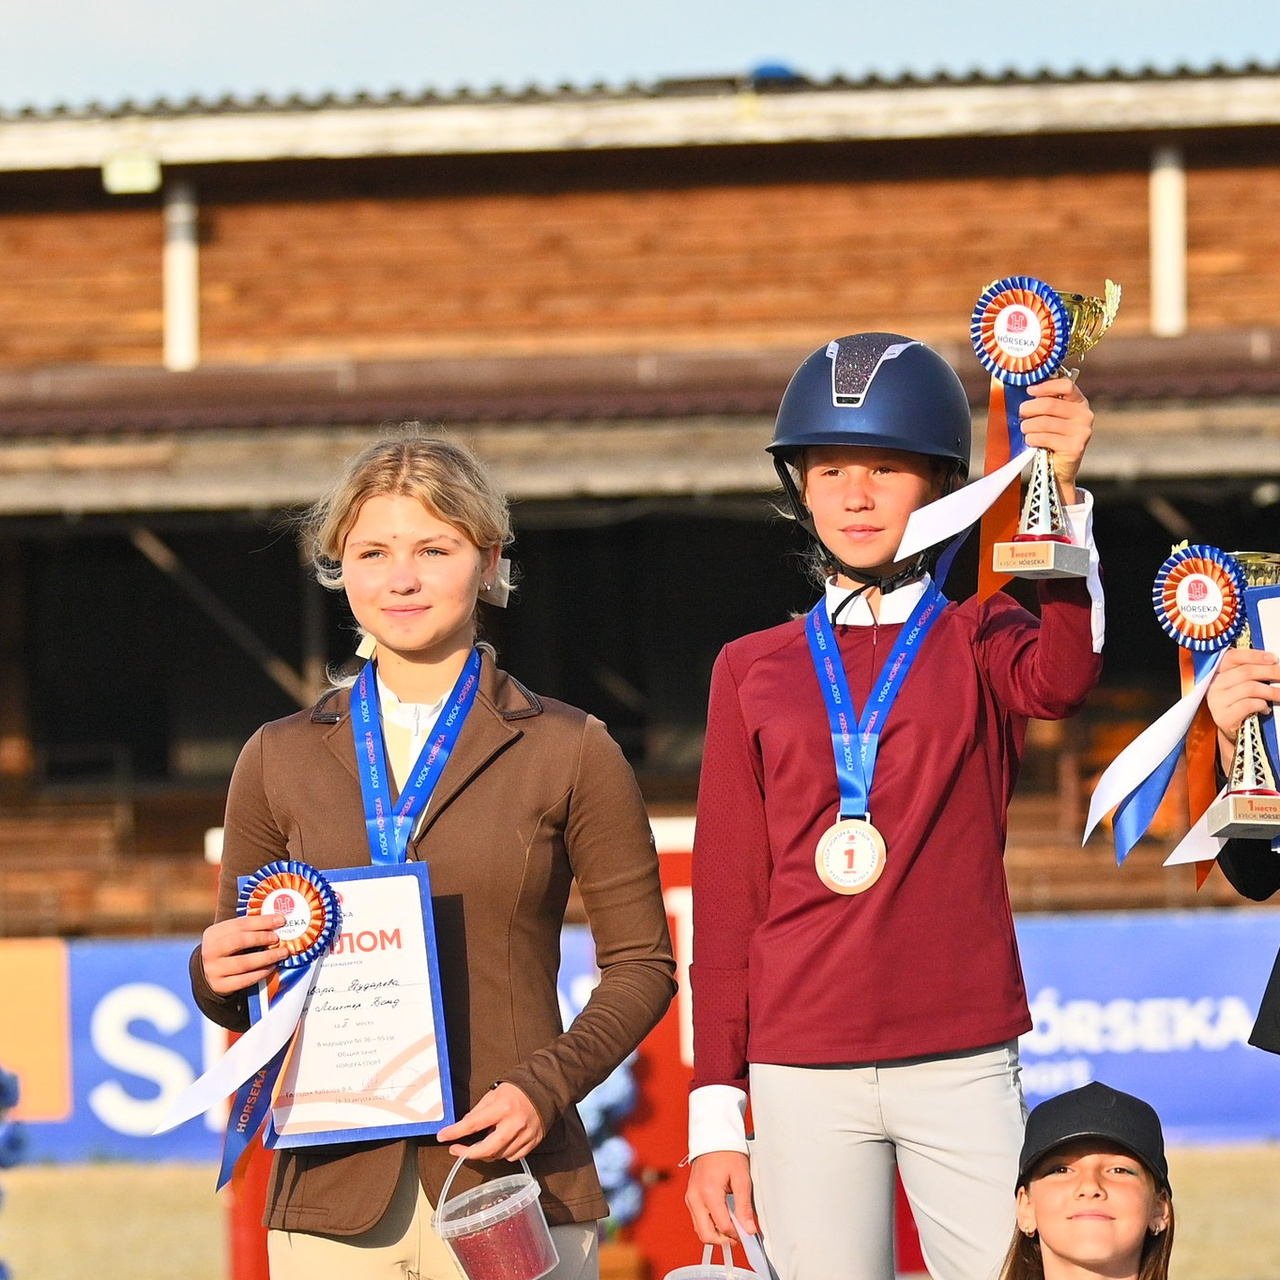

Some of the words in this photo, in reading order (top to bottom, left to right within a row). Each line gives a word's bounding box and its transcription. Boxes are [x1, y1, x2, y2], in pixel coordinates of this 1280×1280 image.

[1181, 604, 1219, 613] HÓRSEKA
[905, 626, 921, 646] КУБОК
[877, 680, 893, 703] КУБОК
[888, 652, 907, 681] HORSEKA
[445, 703, 461, 727] КУБОК
[457, 674, 476, 705] HORSEKA
[831, 683, 842, 704] КУБОК
[361, 700, 370, 722] КУБОК
[838, 712, 850, 745] HORSEKA
[863, 711, 879, 743] HORSEKA
[365, 731, 376, 764] HORSEKA
[844, 746, 853, 771] КУБОК
[415, 766, 431, 788] КУБОК
[426, 734, 446, 766] HORSEKA
[370, 765, 379, 788] КУБОК
[375, 797, 385, 831] HORSEKA
[1247, 800, 1254, 812] 1
[379, 832, 389, 855] КУБОК
[844, 849, 855, 869] 1
[334, 928, 402, 954] ЛОМ
[236, 1069, 267, 1133] HORSEKA
